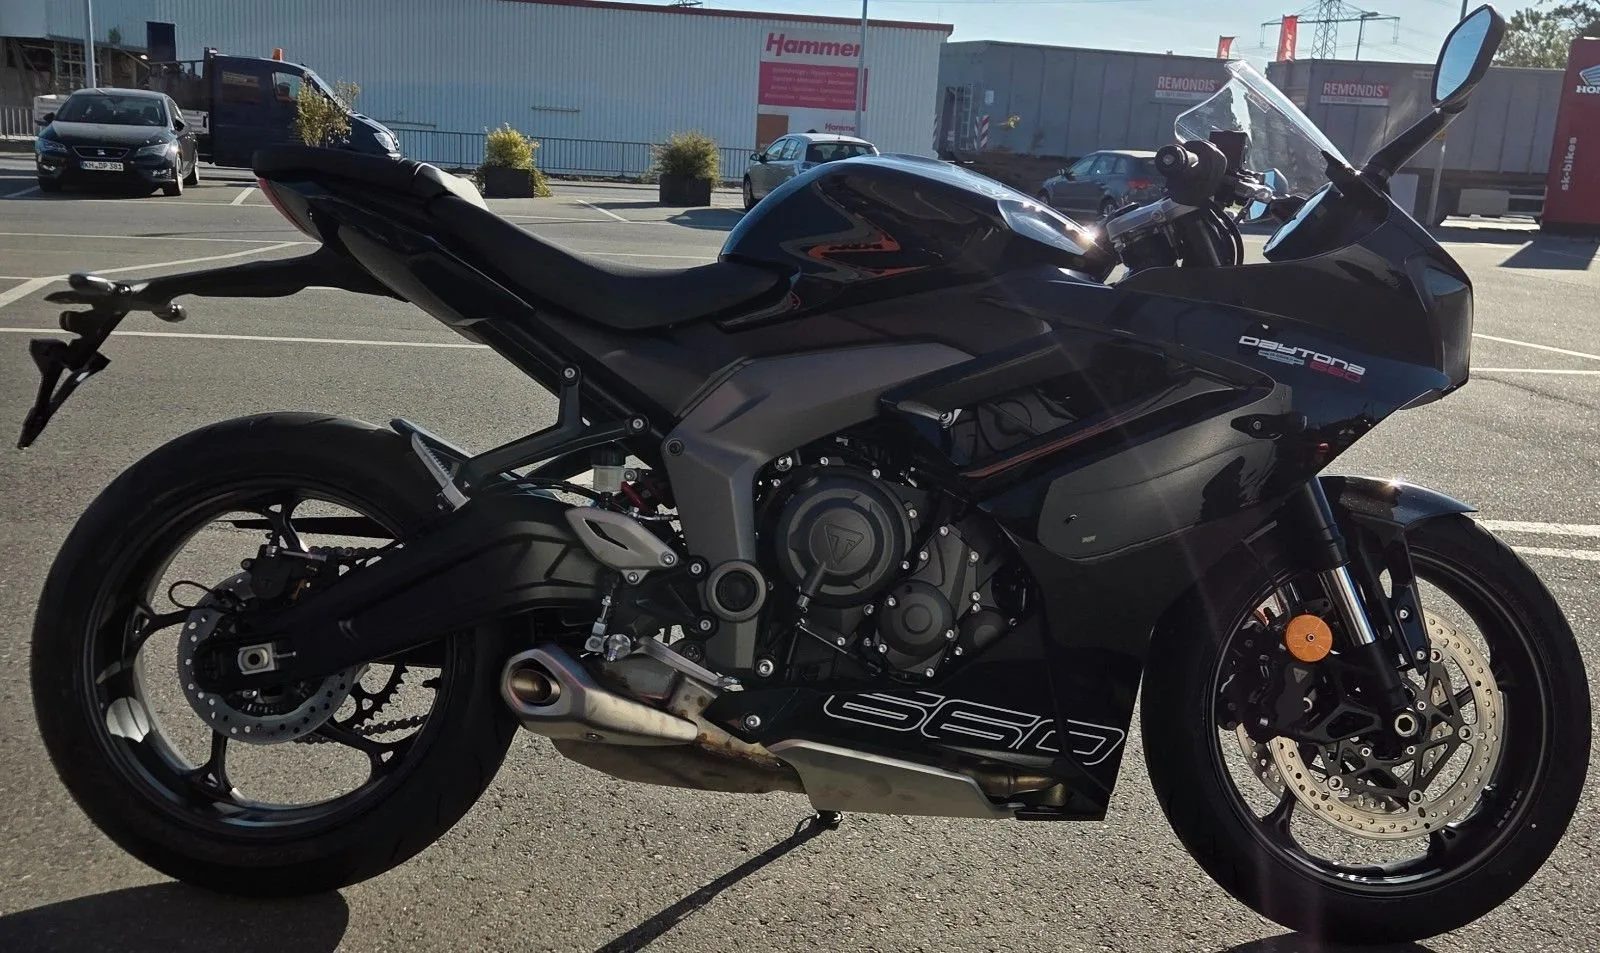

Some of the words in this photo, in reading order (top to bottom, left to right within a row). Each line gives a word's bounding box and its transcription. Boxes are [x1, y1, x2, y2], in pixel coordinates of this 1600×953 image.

[1157, 76, 1216, 91] REMONDIS
[1323, 82, 1384, 97] REMONDIS
[1561, 137, 1578, 190] sk-bikes
[823, 691, 1126, 766] 660
